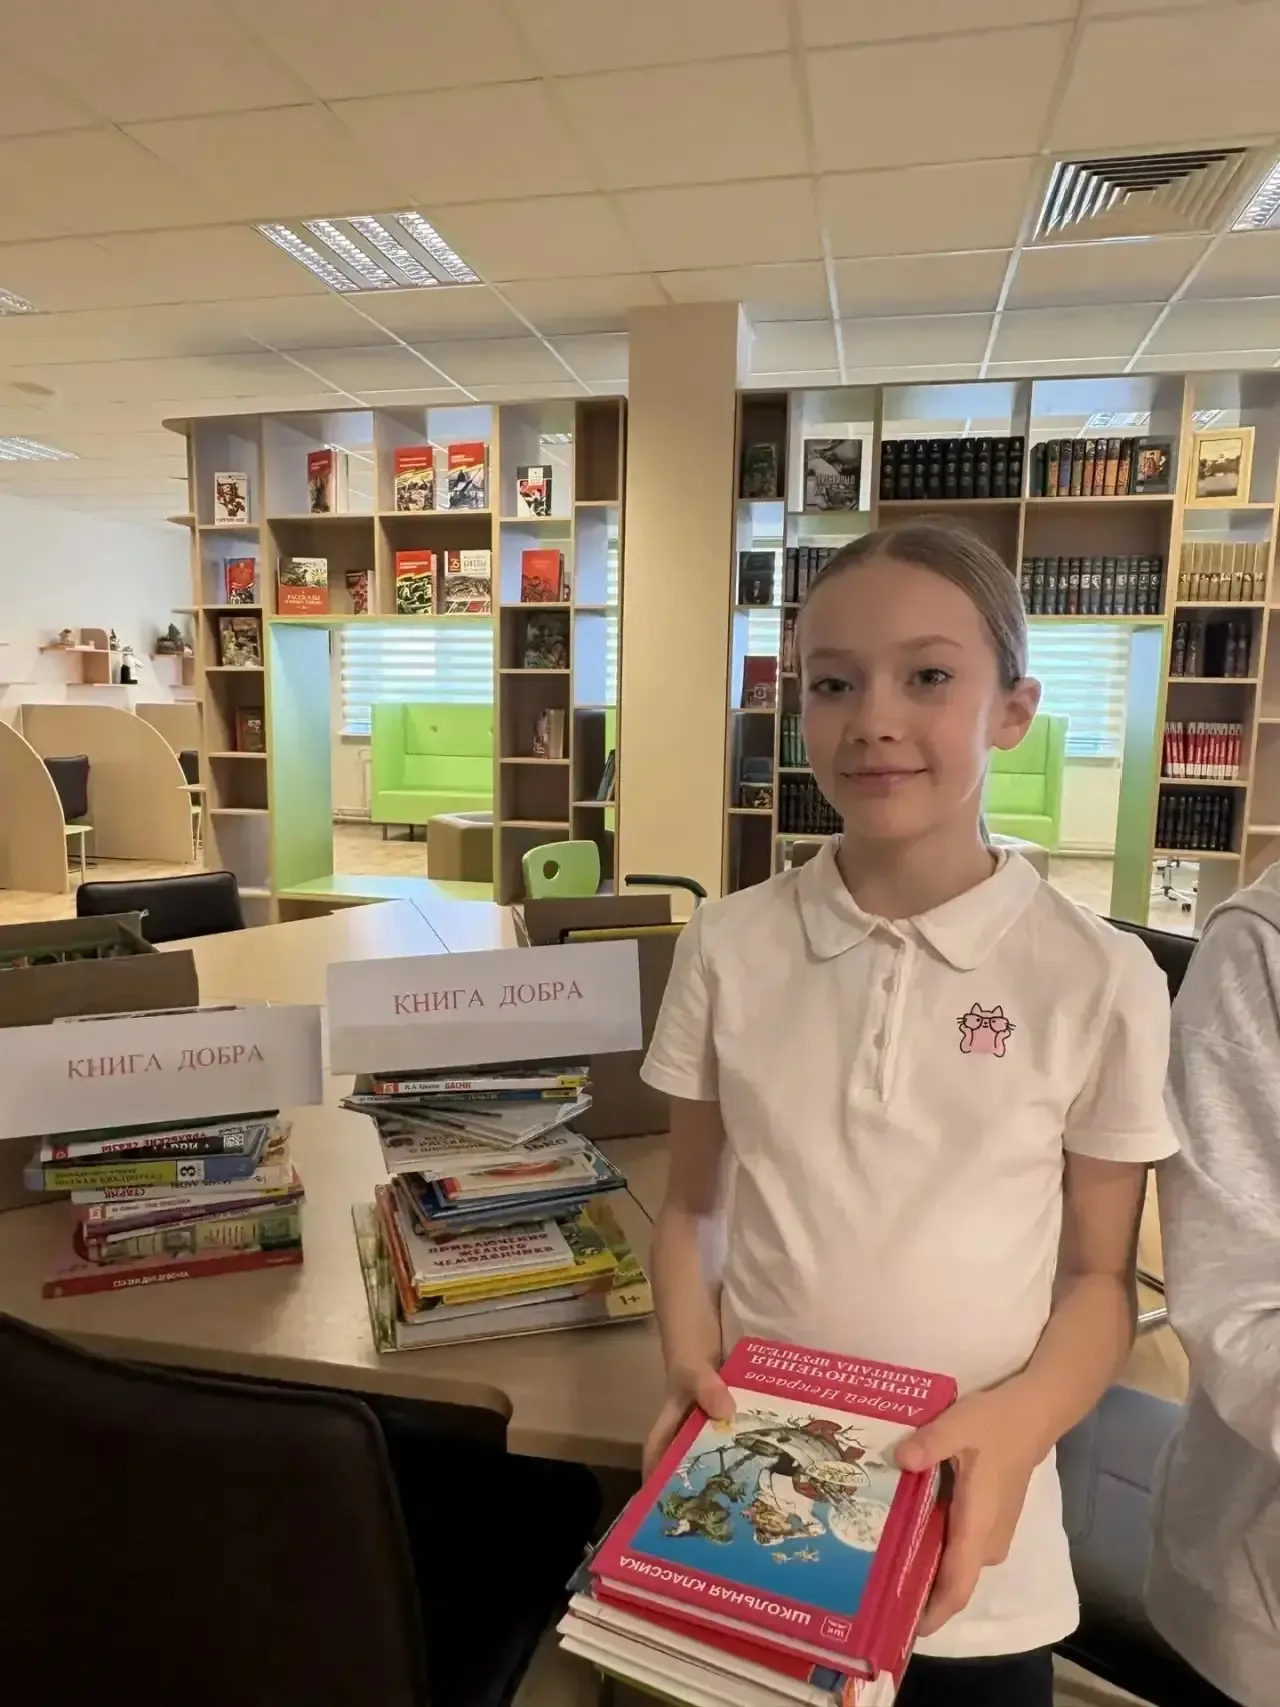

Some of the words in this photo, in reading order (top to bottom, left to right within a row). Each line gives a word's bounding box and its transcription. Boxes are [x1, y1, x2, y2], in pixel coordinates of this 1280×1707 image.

[393, 988, 485, 1015] КНИГА
[500, 979, 584, 1007] ДОБРА
[67, 1051, 163, 1080] КНИГА
[178, 1043, 265, 1073] ДОБРА
[443, 1081, 473, 1091] БАСНИ
[428, 1233, 548, 1254] ПРИКЛЮЧЕНИЯ
[433, 1246, 555, 1267] ЧЕМОДАНЧИКА
[745, 1342, 832, 1368] ВРУНГЕЛЯ
[743, 1370, 841, 1402] Некрасов
[749, 1353, 930, 1400] ПРИКЛЮЧЕНИЯ
[835, 1360, 934, 1388] КАПИТАНА
[843, 1391, 925, 1418] Андрей
[618, 1554, 707, 1593] КЛАССИКА
[707, 1584, 812, 1626] ШКОЛЬНАЯ
